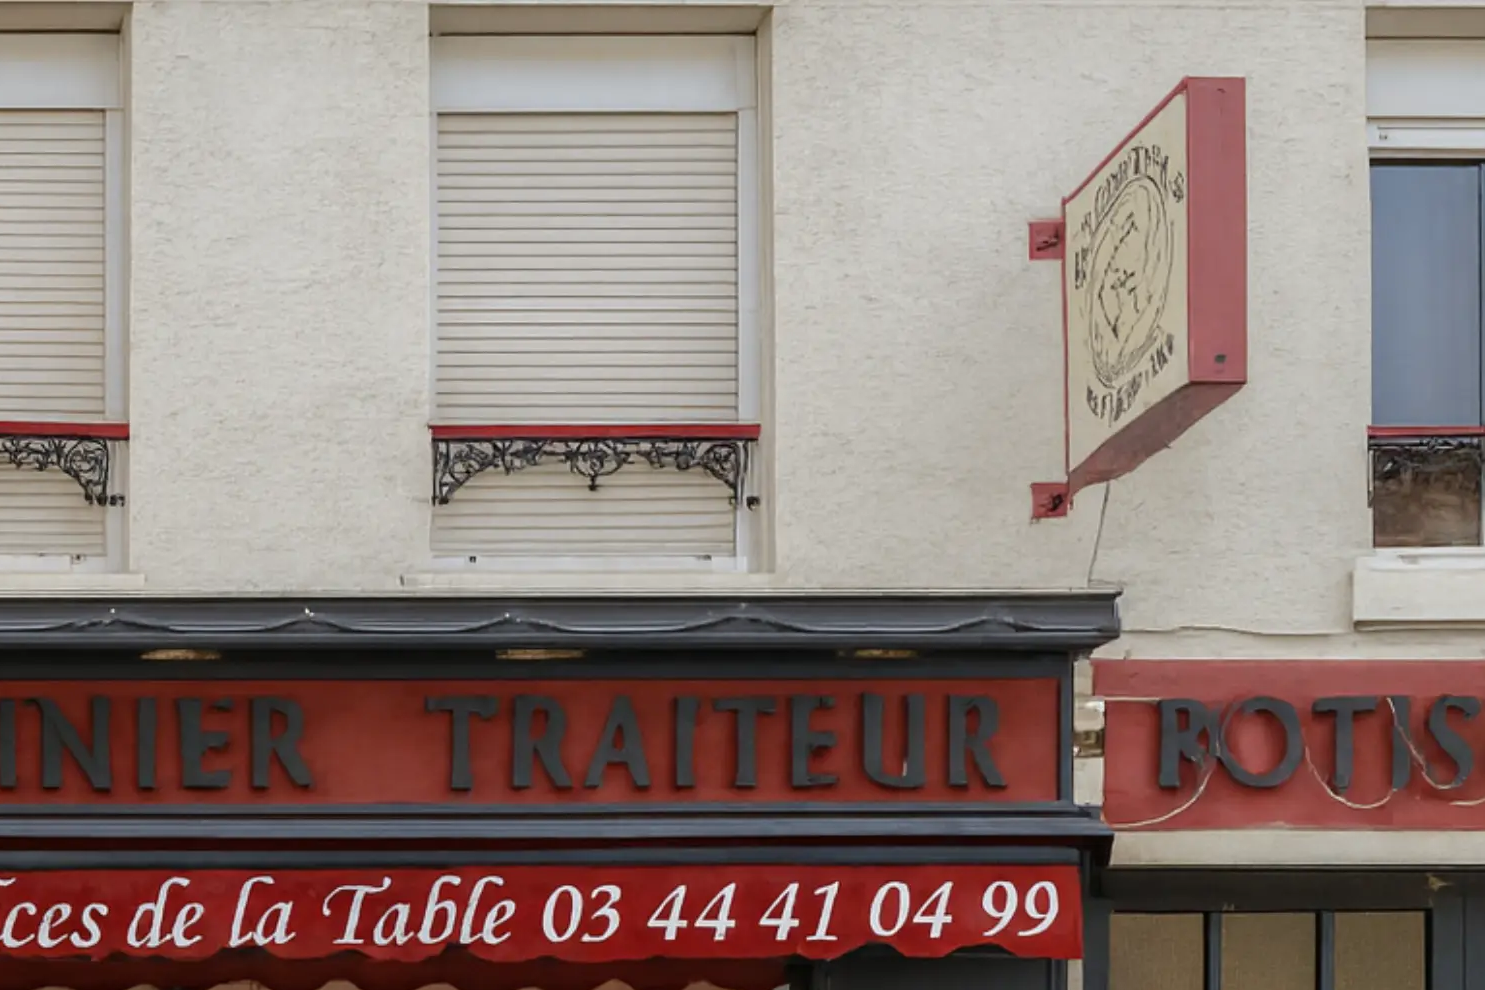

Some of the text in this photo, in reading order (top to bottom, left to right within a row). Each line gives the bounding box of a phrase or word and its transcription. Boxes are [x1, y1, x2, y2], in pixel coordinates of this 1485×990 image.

[423, 693, 1009, 791] TRAITEUR
[1157, 695, 1481, 794] ROTIS
[126, 875, 206, 949] de
[227, 875, 296, 949] la
[322, 875, 516, 947] Table
[542, 884, 622, 944] 03
[647, 883, 736, 941] 44
[758, 881, 840, 941] 41
[869, 881, 954, 939] 04
[981, 880, 1059, 938] 99
